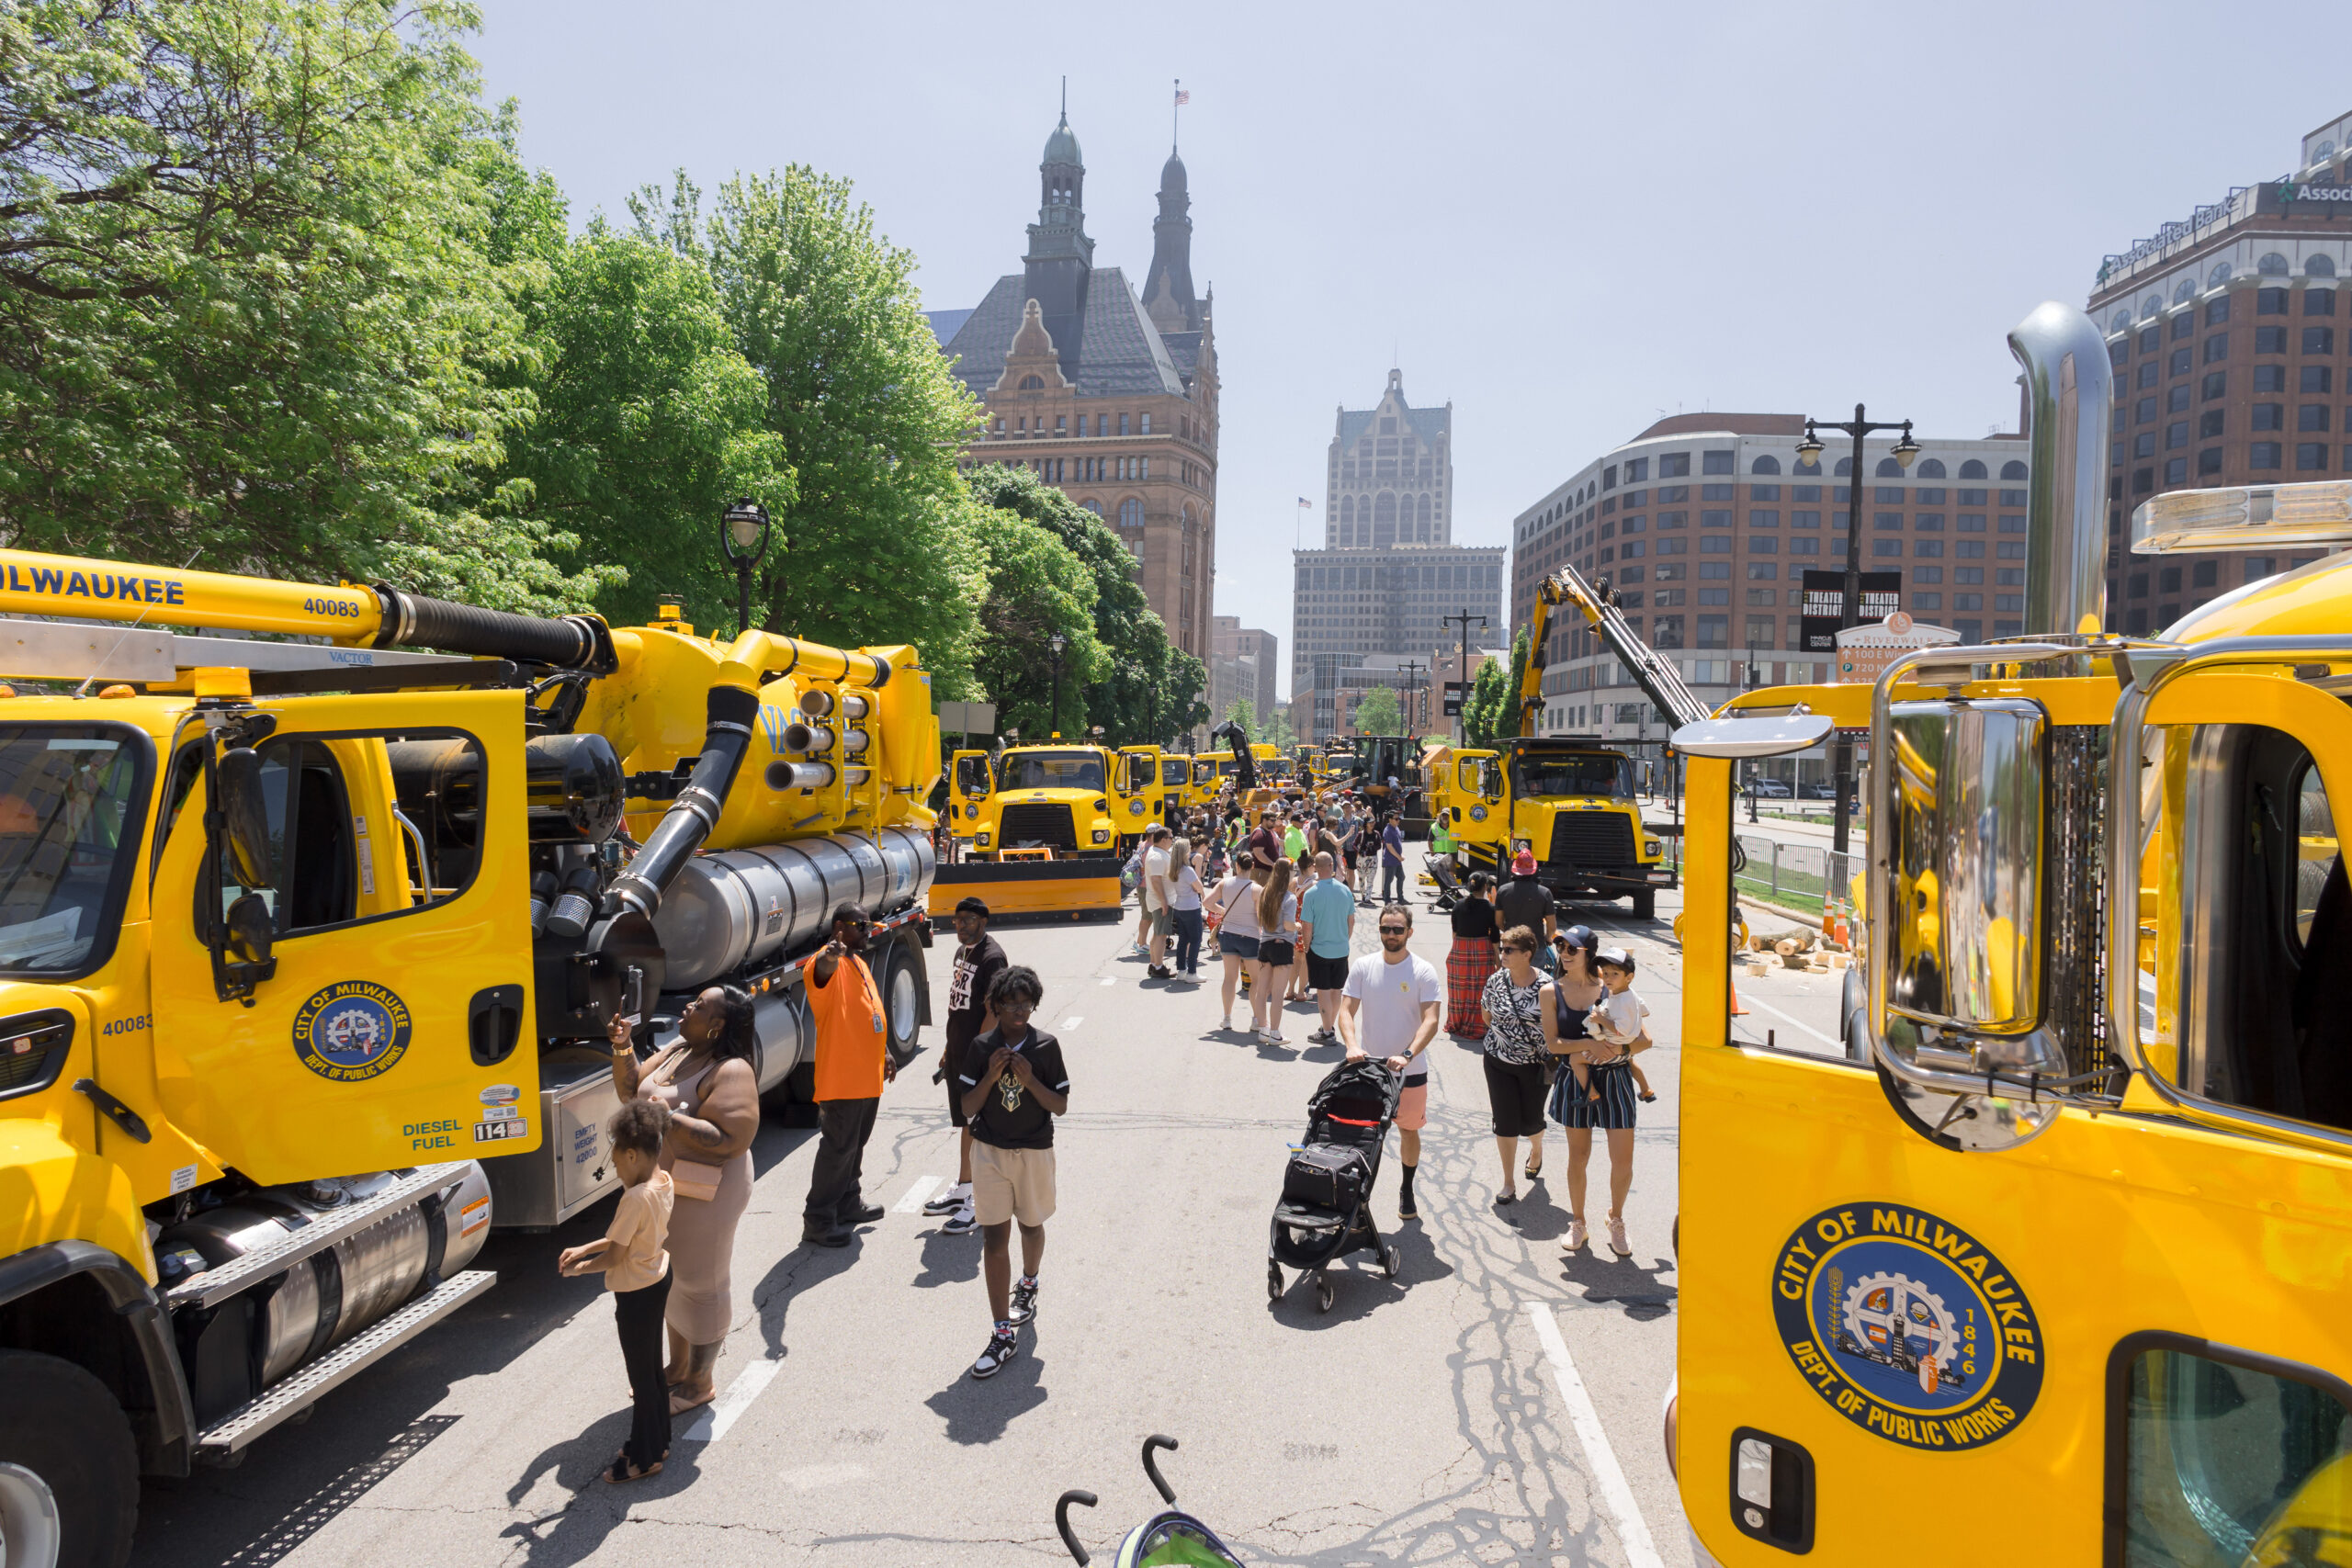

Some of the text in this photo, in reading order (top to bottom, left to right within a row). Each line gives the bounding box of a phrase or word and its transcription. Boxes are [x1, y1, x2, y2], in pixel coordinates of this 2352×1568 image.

[2108, 197, 2233, 273] Associated Bank
[1809, 591, 1843, 604] THEATER
[1865, 592, 1899, 605] THEATER
[303, 598, 359, 618] 40083
[1803, 604, 1843, 616] DISTRICT
[329, 650, 374, 664] VACTOR
[1855, 650, 1874, 659] 100
[1877, 650, 1883, 659] E
[1854, 664, 1875, 672] 720
[1332, 780, 1353, 792] CASE
[295, 983, 409, 1040] CITY OF MILWAUKEE
[102, 1013, 153, 1037] 40083
[304, 1045, 404, 1080] DEPT. OF PUBLIC WORKS
[402, 1119, 463, 1137] DIESEL
[476, 1122, 506, 1140] 114
[574, 1122, 596, 1140] EMPTY
[412, 1135, 456, 1152] FUEL
[574, 1134, 597, 1151] WEIGHT
[575, 1146, 597, 1164] 42000
[1779, 1208, 2037, 1365] CITY OF MILWAUKEE
[1962, 1308, 1977, 1376] 1846
[1790, 1338, 2018, 1448] DEPT. OF PUBLIC WORKS
